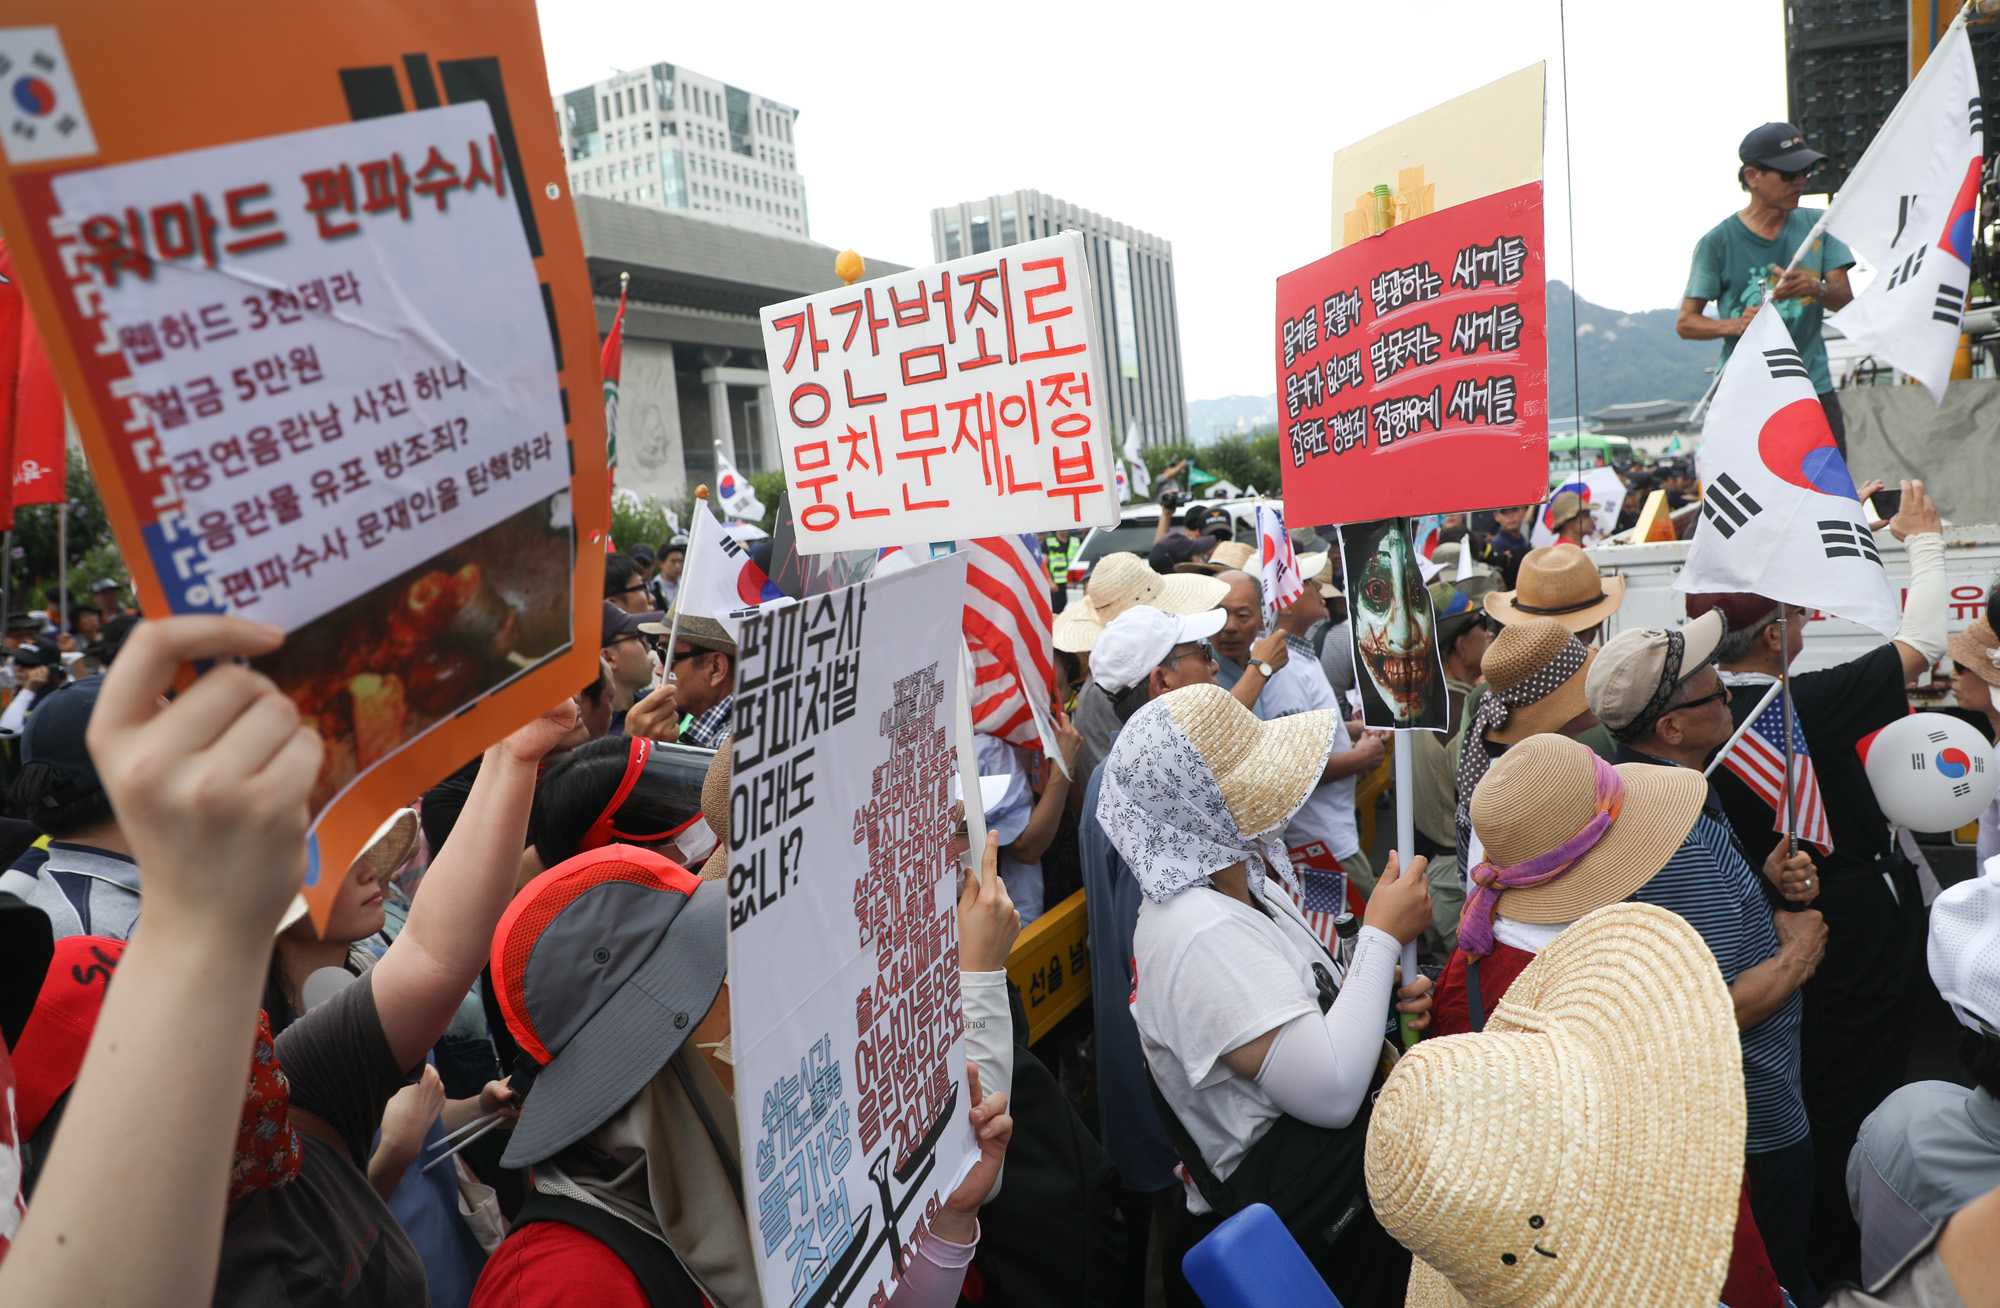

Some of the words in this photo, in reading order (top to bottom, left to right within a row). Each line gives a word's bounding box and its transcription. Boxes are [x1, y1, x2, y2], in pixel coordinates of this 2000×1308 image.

[81, 183, 286, 286] 워마드
[300, 133, 508, 241] 편파수사
[119, 303, 239, 365] 웹하드
[242, 271, 362, 329] 3천테라
[772, 256, 1087, 428] 강간범죄로
[1283, 307, 1318, 366] 몰카를
[1323, 286, 1363, 341] 못볼까
[1370, 261, 1444, 319] 발광하는
[1450, 234, 1529, 288] 새끼들
[147, 371, 223, 429] 벌금
[232, 345, 324, 403] 5만원
[1285, 362, 1325, 419] 몰카가
[1325, 349, 1364, 397] 없으면
[1369, 322, 1442, 384] 딸못치는
[1450, 302, 1524, 353] 새끼들
[174, 409, 342, 492] 공연음란남
[352, 380, 409, 427] 사진
[415, 359, 469, 405] 하나
[1288, 417, 1329, 468] 잡혀도
[1327, 404, 1369, 456] 경범죄
[1372, 384, 1442, 446] 집행유예
[1447, 376, 1517, 425] 새끼들
[197, 482, 302, 551] 음란물
[310, 459, 368, 508] 유포
[374, 418, 471, 482] 방조죄?
[221, 530, 349, 610] 편파수사
[358, 477, 459, 552] 문재인을
[467, 432, 552, 495] 탄핵하라
[738, 581, 867, 695] 편파수사
[733, 650, 861, 777] 편파처벌
[730, 746, 816, 851] 이래도
[872, 746, 915, 797] 흉기위협
[729, 826, 804, 933] 없나?
[963, 1020, 986, 1029] POLIC
[1029, 955, 1063, 1008] 선을
[762, 1033, 831, 1130] 쉬는시간
